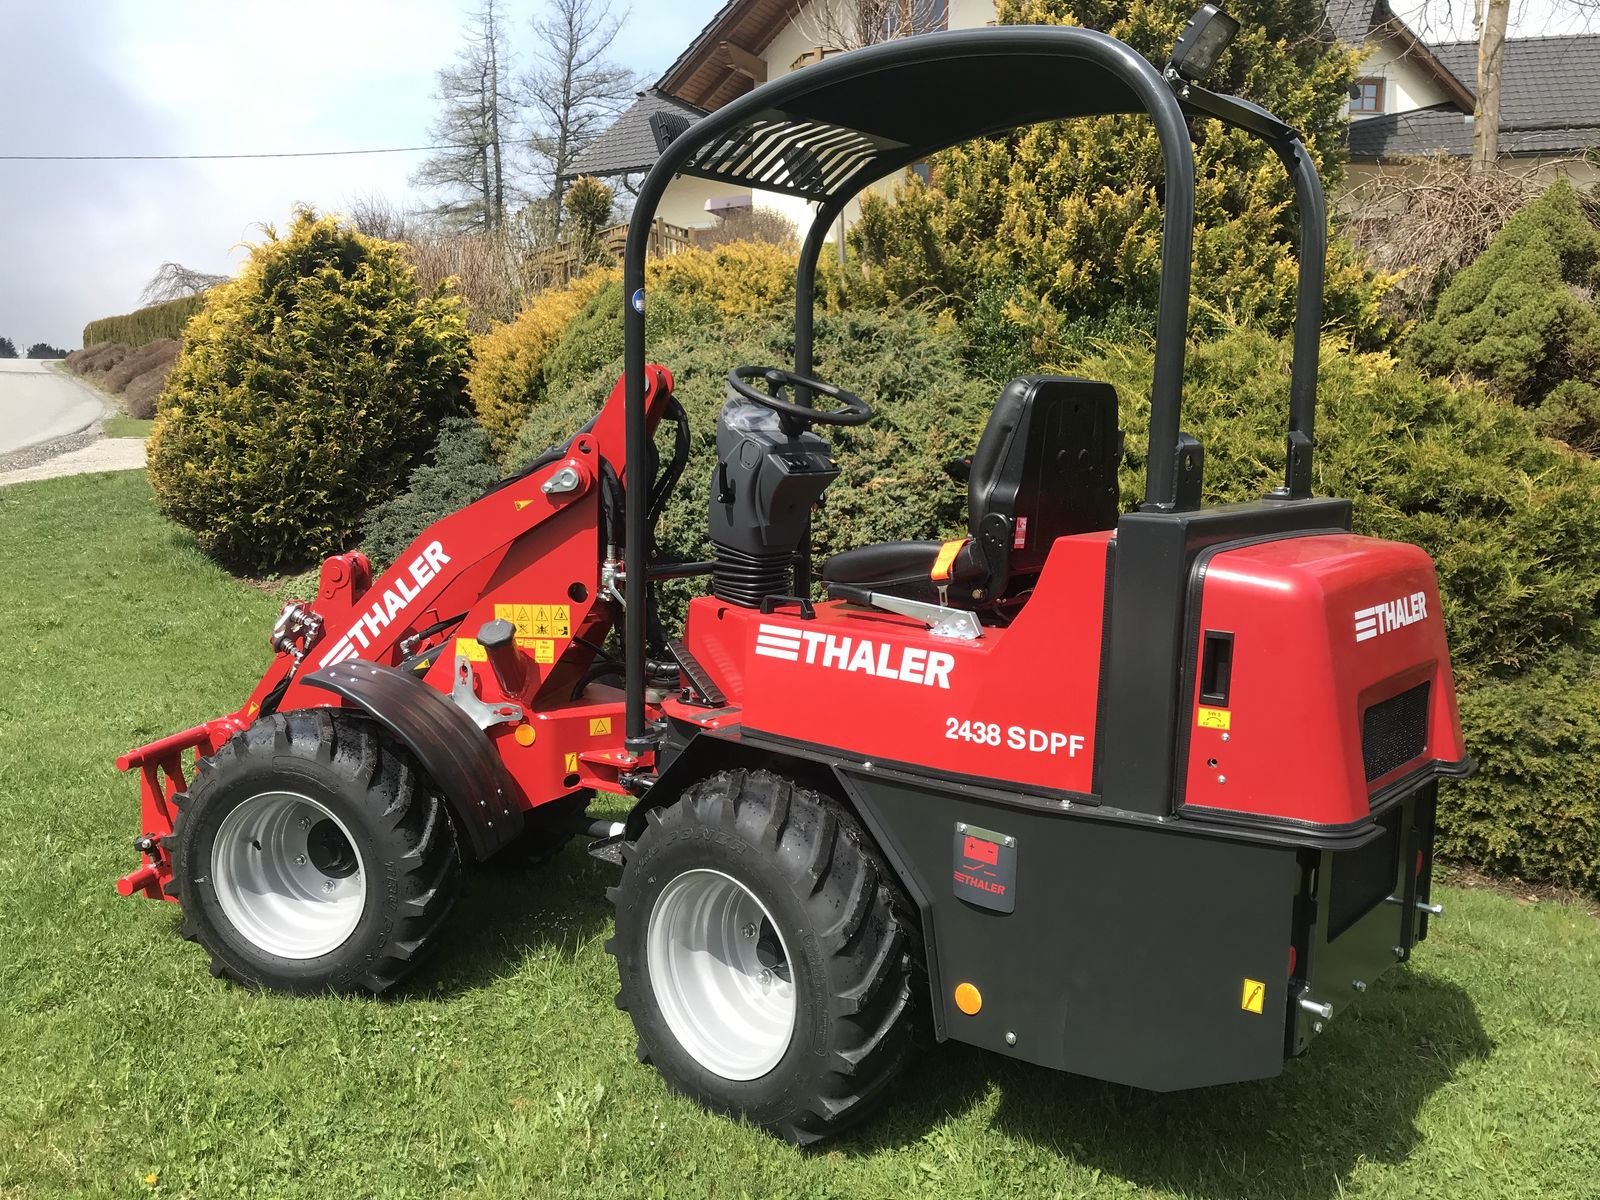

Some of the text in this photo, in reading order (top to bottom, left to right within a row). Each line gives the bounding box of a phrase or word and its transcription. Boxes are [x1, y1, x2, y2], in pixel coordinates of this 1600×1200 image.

[346, 540, 452, 649] THALER
[1375, 591, 1428, 635] THALER
[800, 630, 955, 689] THALER
[945, 717, 1001, 746] 2438
[963, 875, 1006, 896] THALER
